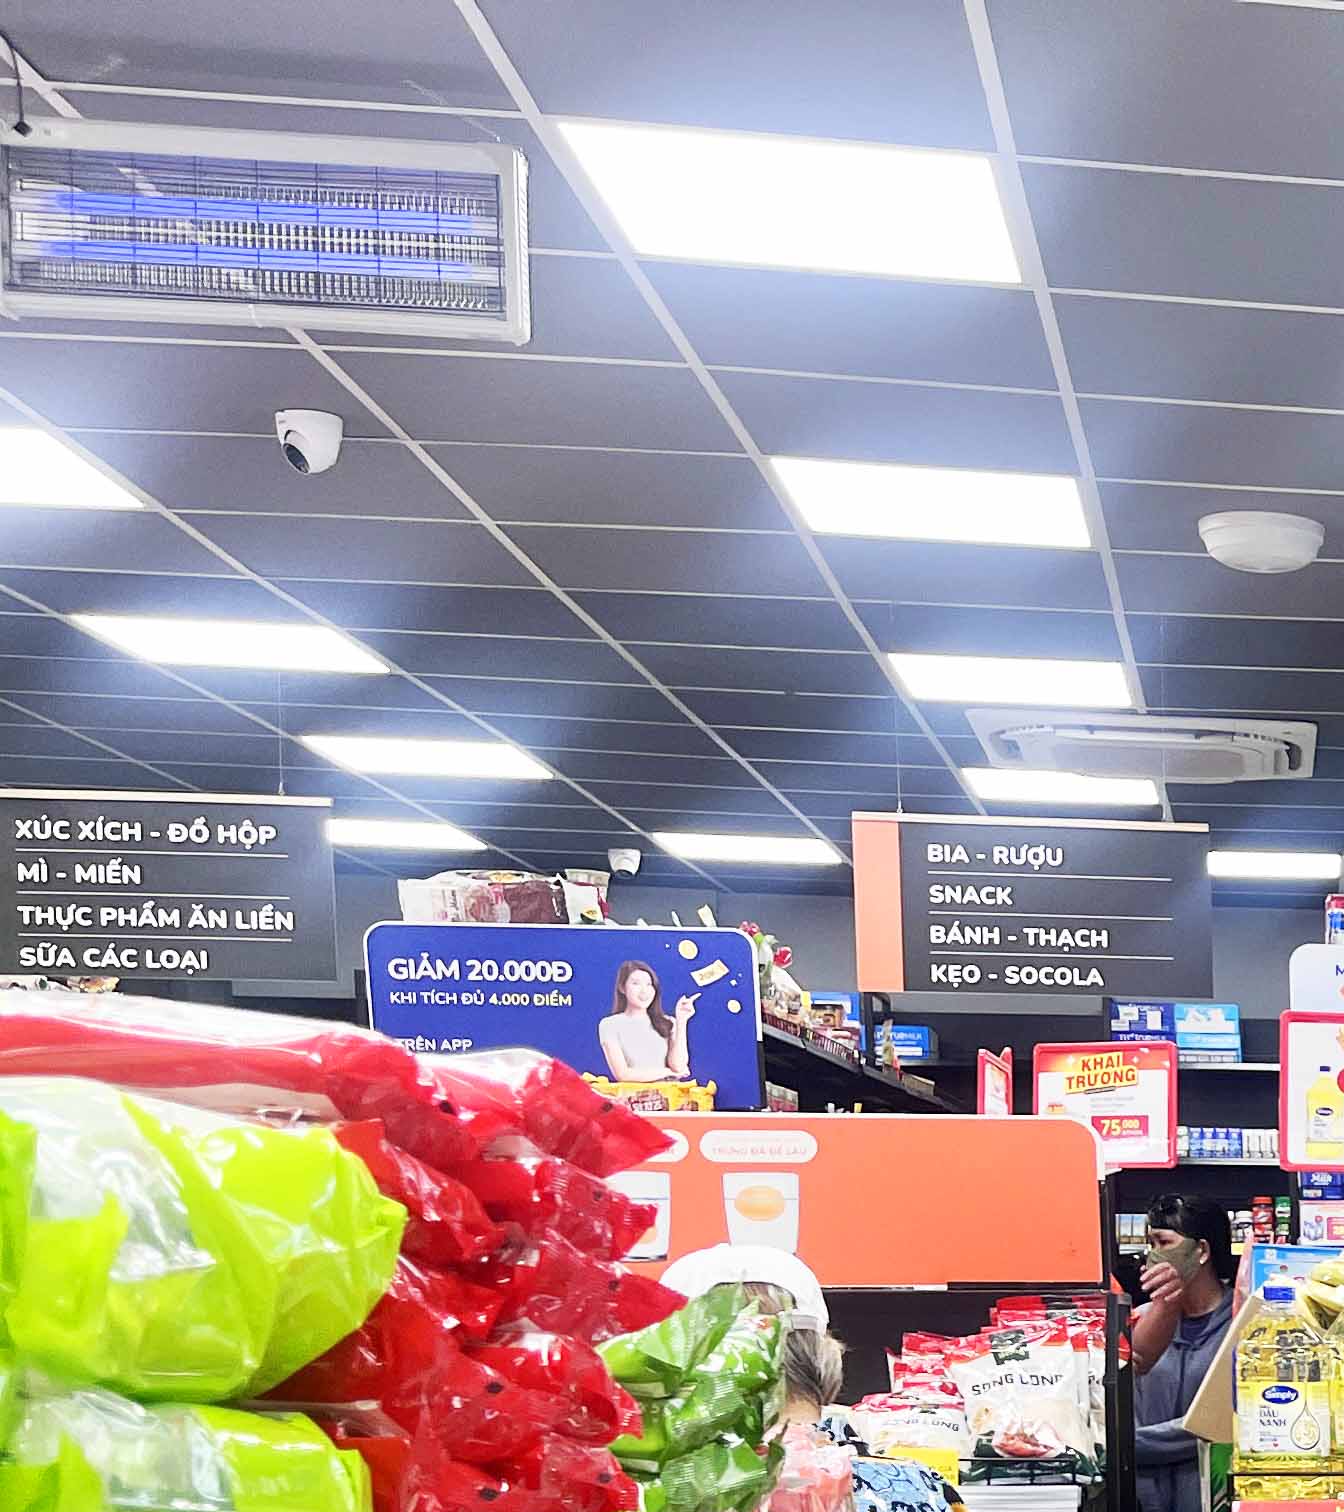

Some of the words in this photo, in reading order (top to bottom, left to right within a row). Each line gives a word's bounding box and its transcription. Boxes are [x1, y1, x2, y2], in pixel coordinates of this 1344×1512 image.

[15, 815, 70, 840] XÚC
[78, 816, 142, 842] XÍCH
[167, 816, 210, 843] ĐỒ
[217, 819, 277, 850] HỘP
[927, 843, 969, 864] BIA
[992, 844, 1063, 870] RƯỢU
[17, 857, 48, 883] MÌ
[75, 857, 142, 885] MIẾN
[929, 884, 1013, 905] SNACK
[17, 904, 93, 931] THỰC
[100, 900, 180, 928] PHẨM
[188, 904, 228, 930] ĂN
[235, 904, 294, 932] LIỀN
[929, 921, 1000, 945] BÁNH
[1022, 927, 1108, 952] THẠCH
[19, 942, 76, 968] SỮA
[82, 943, 138, 969] CÁC
[145, 949, 208, 975] LOẠI
[387, 951, 460, 982] GIẢM
[465, 959, 573, 983] 20.000Đ
[930, 964, 980, 988] KẸO
[1004, 965, 1105, 987] SOCOLA
[389, 991, 417, 1005] KHI
[419, 989, 458, 1006] TÍCH
[460, 988, 485, 1006] ĐỦ
[488, 993, 530, 1007] 4.000
[533, 990, 572, 1007] ĐIỂM
[440, 1038, 473, 1051] APP
[1081, 1055, 1122, 1073] KHAI
[1065, 1069, 1136, 1090] TRƯƠNG
[971, 1374, 1014, 1396] SONG
